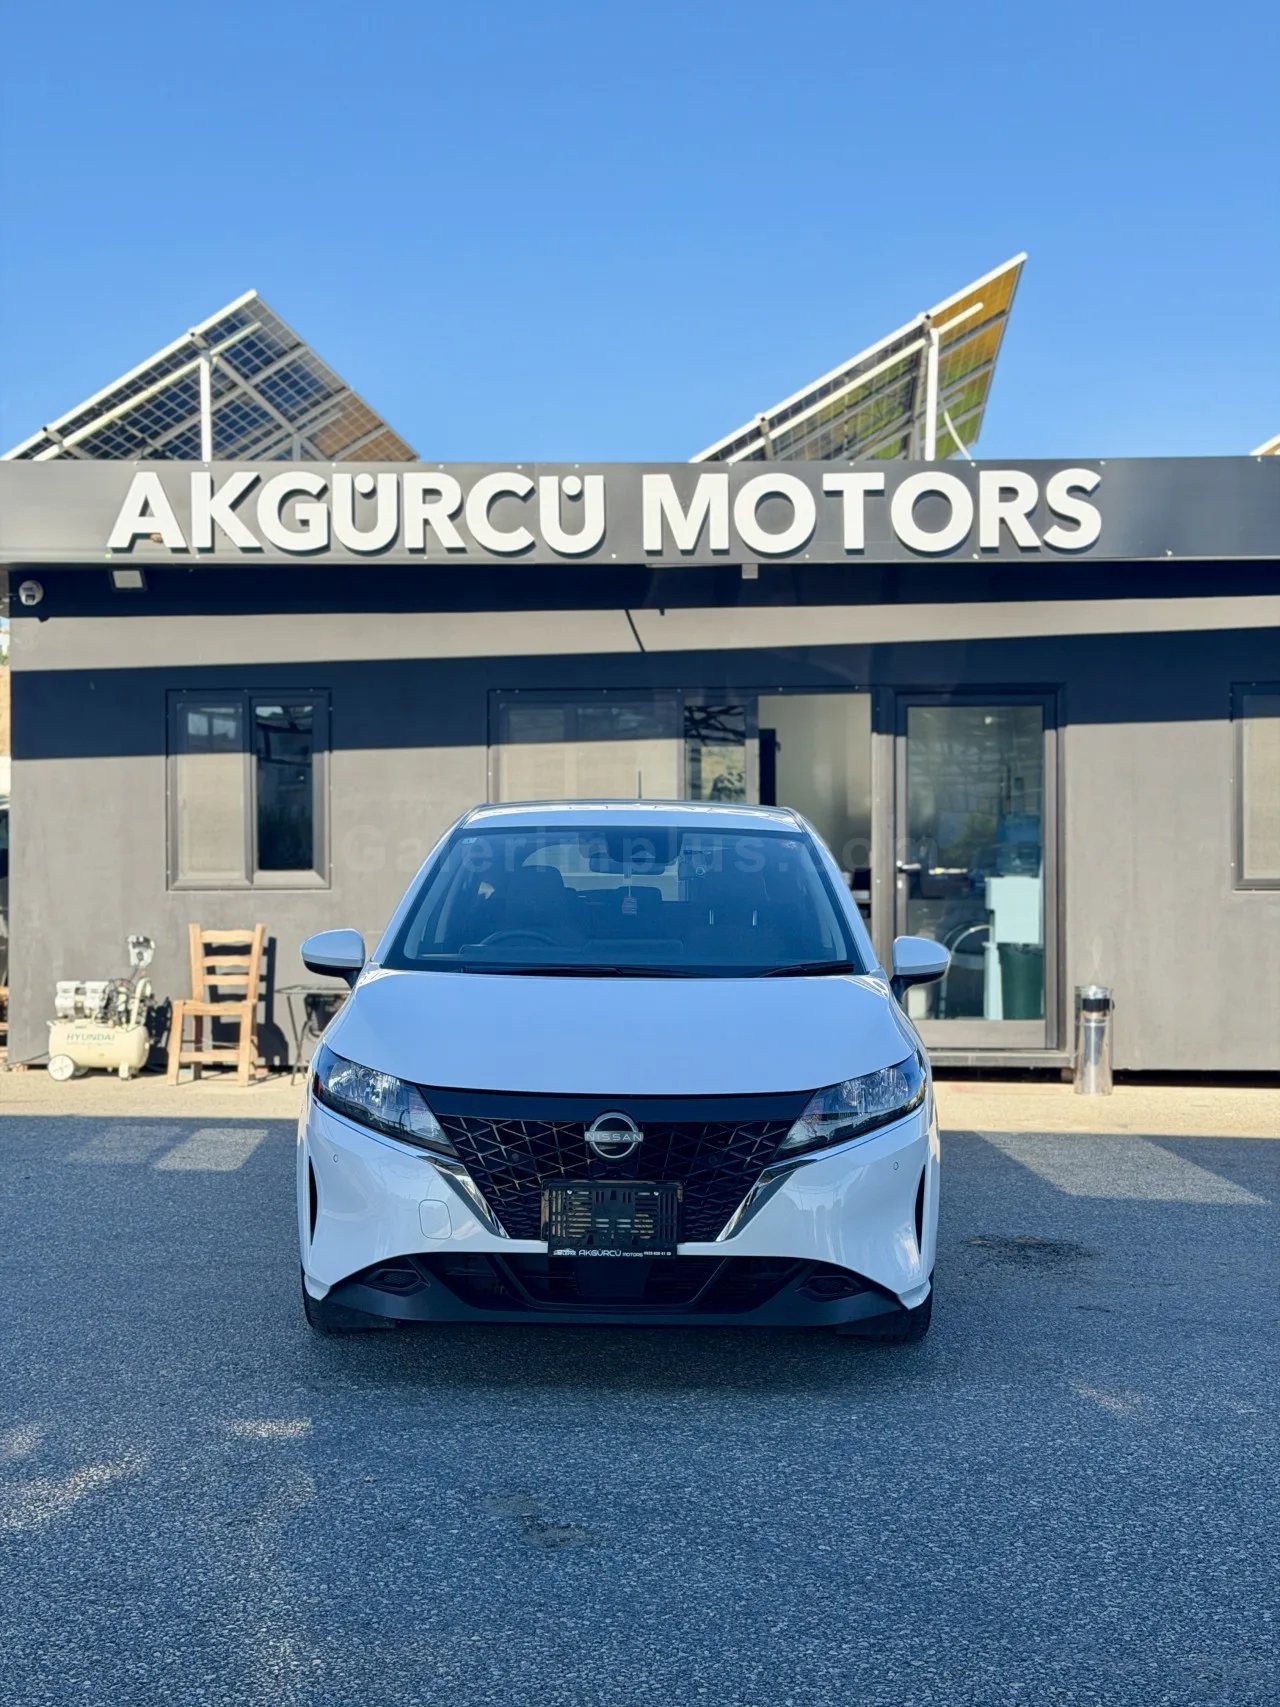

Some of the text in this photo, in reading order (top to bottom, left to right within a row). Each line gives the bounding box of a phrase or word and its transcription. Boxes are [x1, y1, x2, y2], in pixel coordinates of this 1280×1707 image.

[107, 468, 1103, 555] AKGÜRCÜ MOTORS
[66, 1033, 115, 1041] HYUNDAI
[586, 1132, 643, 1142] NISSAN
[578, 1248, 622, 1257] AKGÜRCÜ
